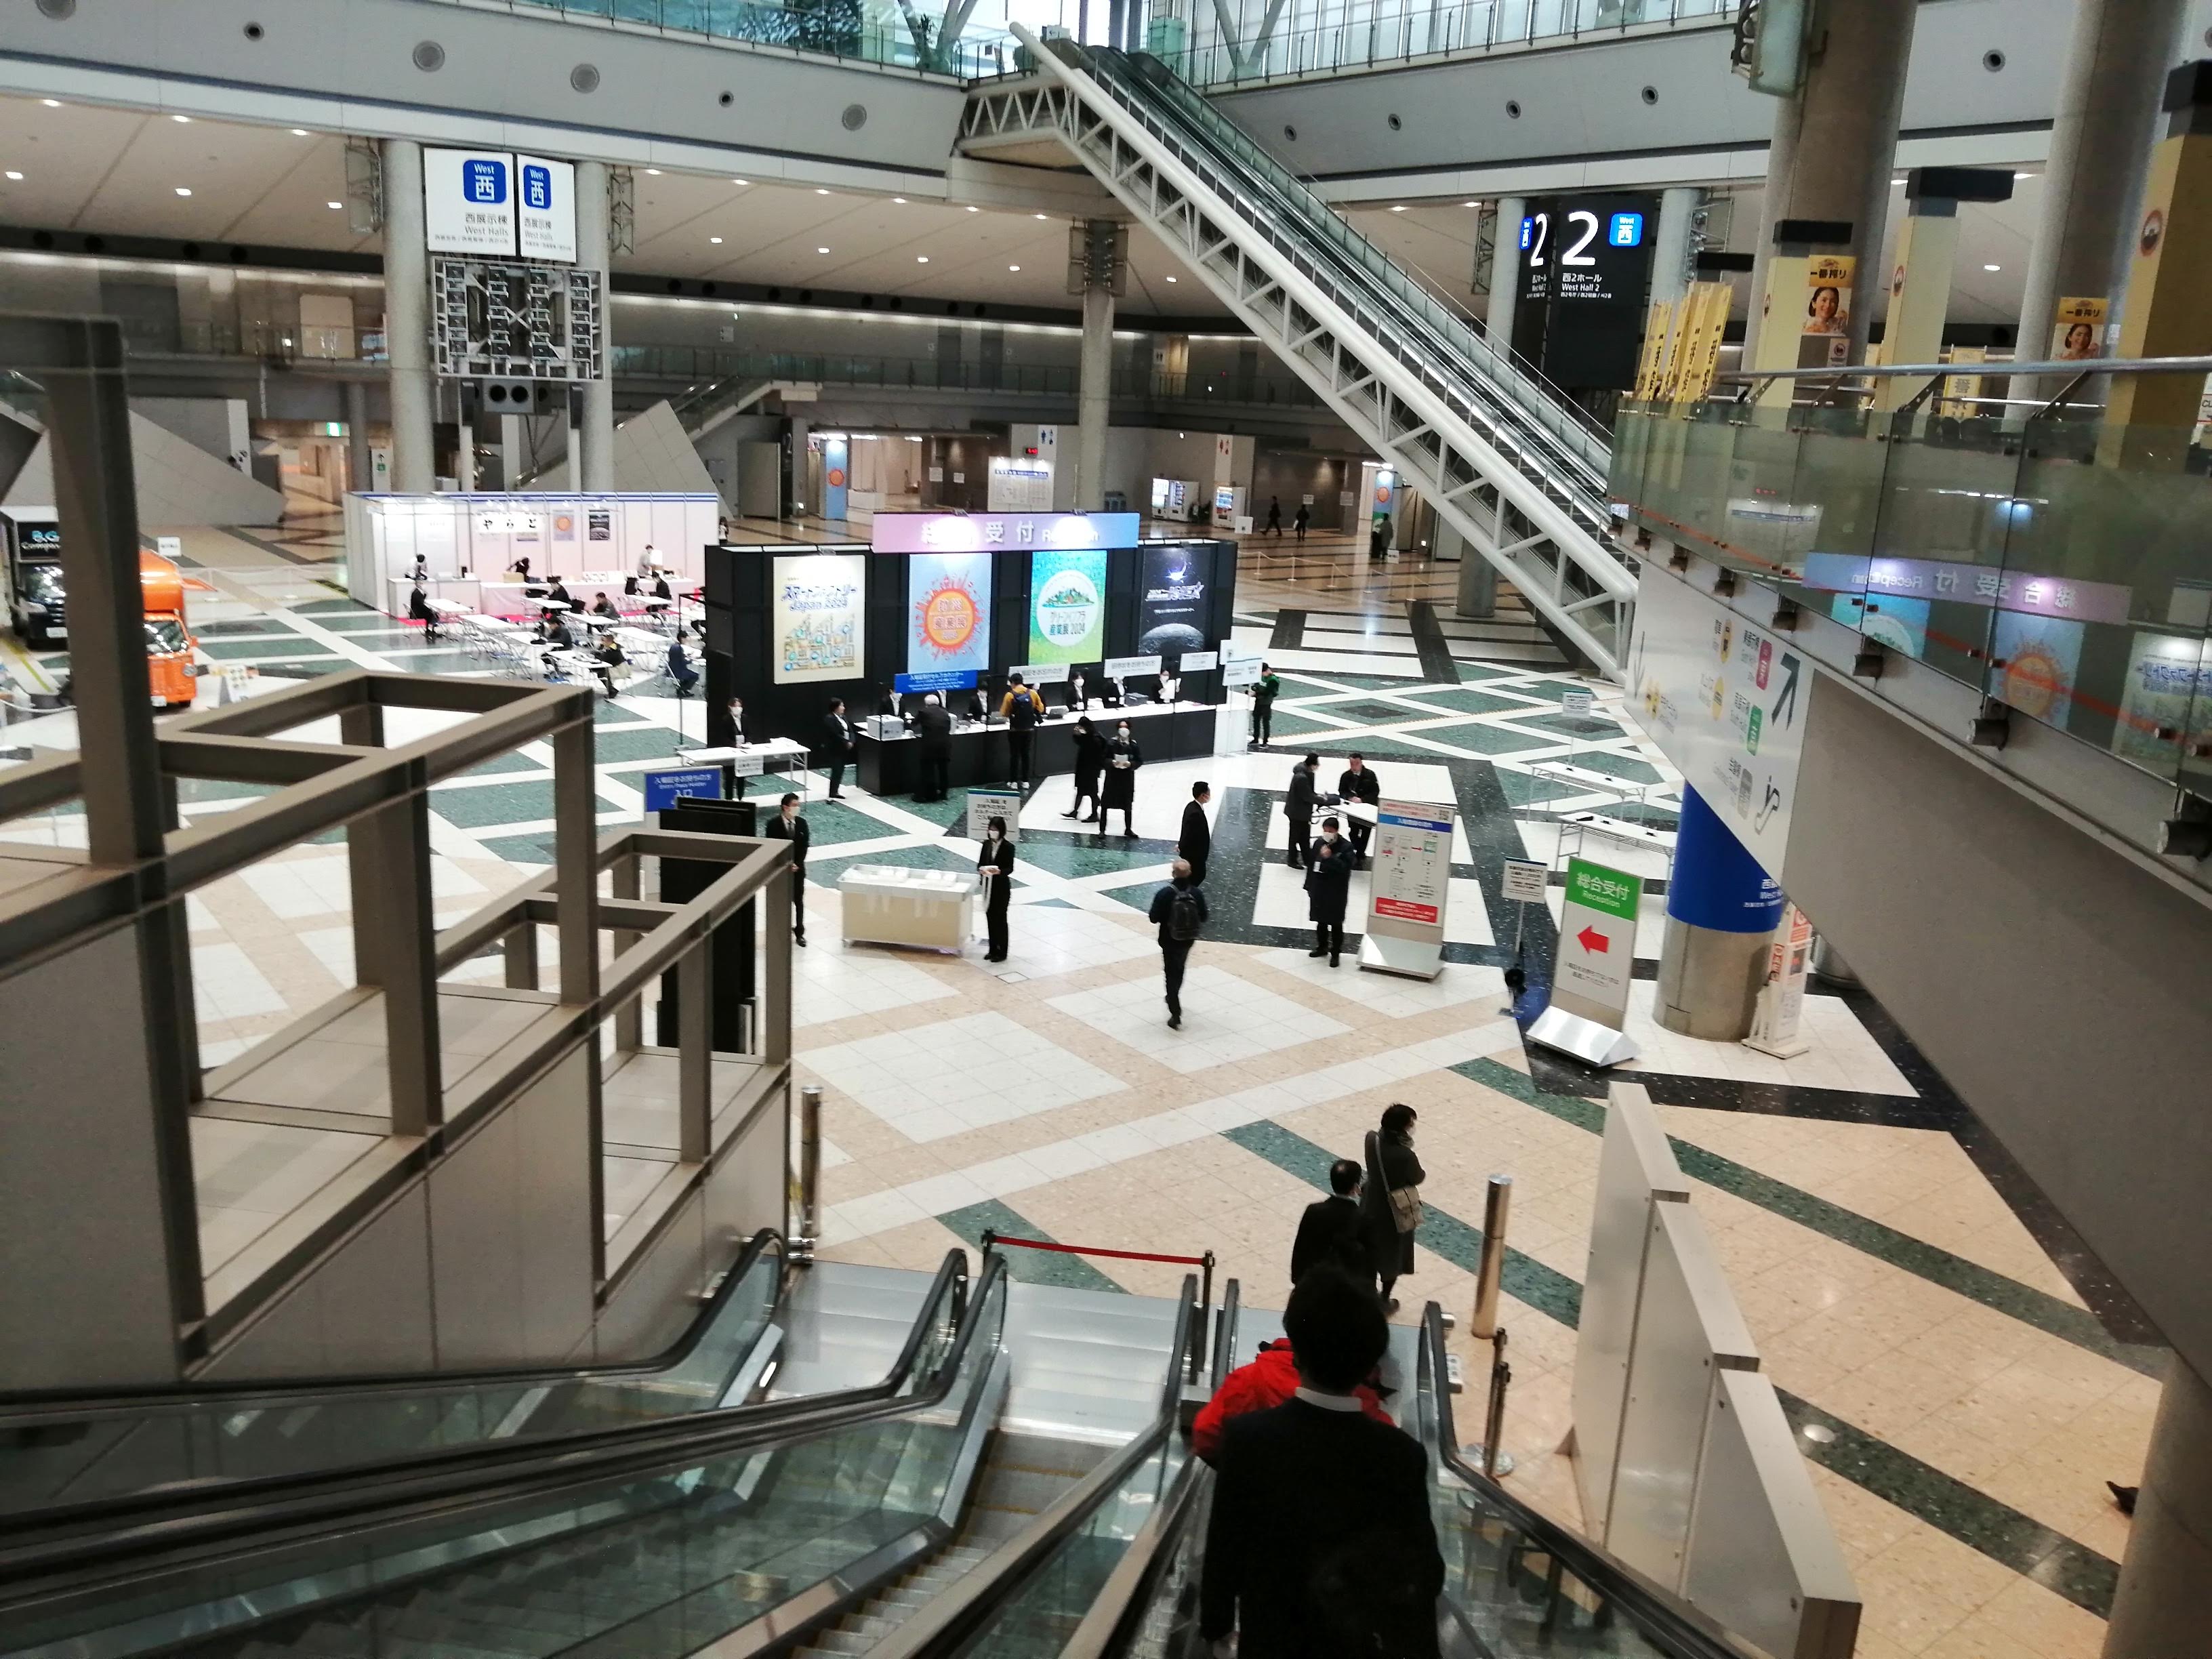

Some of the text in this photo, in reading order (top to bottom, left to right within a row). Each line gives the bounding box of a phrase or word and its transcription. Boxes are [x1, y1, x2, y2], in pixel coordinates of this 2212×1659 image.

[474, 163, 495, 174] West
[530, 169, 544, 180] West
[475, 176, 495, 201] 西
[531, 180, 544, 206] 西
[466, 213, 508, 225] 西展示棟
[524, 216, 552, 230] 西展示棟
[1619, 216, 1635, 224] West
[465, 226, 509, 237] West Halls
[1617, 225, 1634, 244] 西
[1530, 213, 1548, 267] 2
[1561, 211, 1599, 266] 2
[1562, 272, 1602, 283] 西2ホール
[1810, 268, 1847, 279] 一番搾り
[1561, 283, 1600, 292] West Hall 2
[2066, 308, 2100, 318] 一番搾り
[1050, 611, 1086, 623] グリーンインフラ
[1049, 623, 1086, 636] 産業展 2024
[1576, 872, 1630, 901] 総合受付
[1582, 890, 1621, 908] Reception
